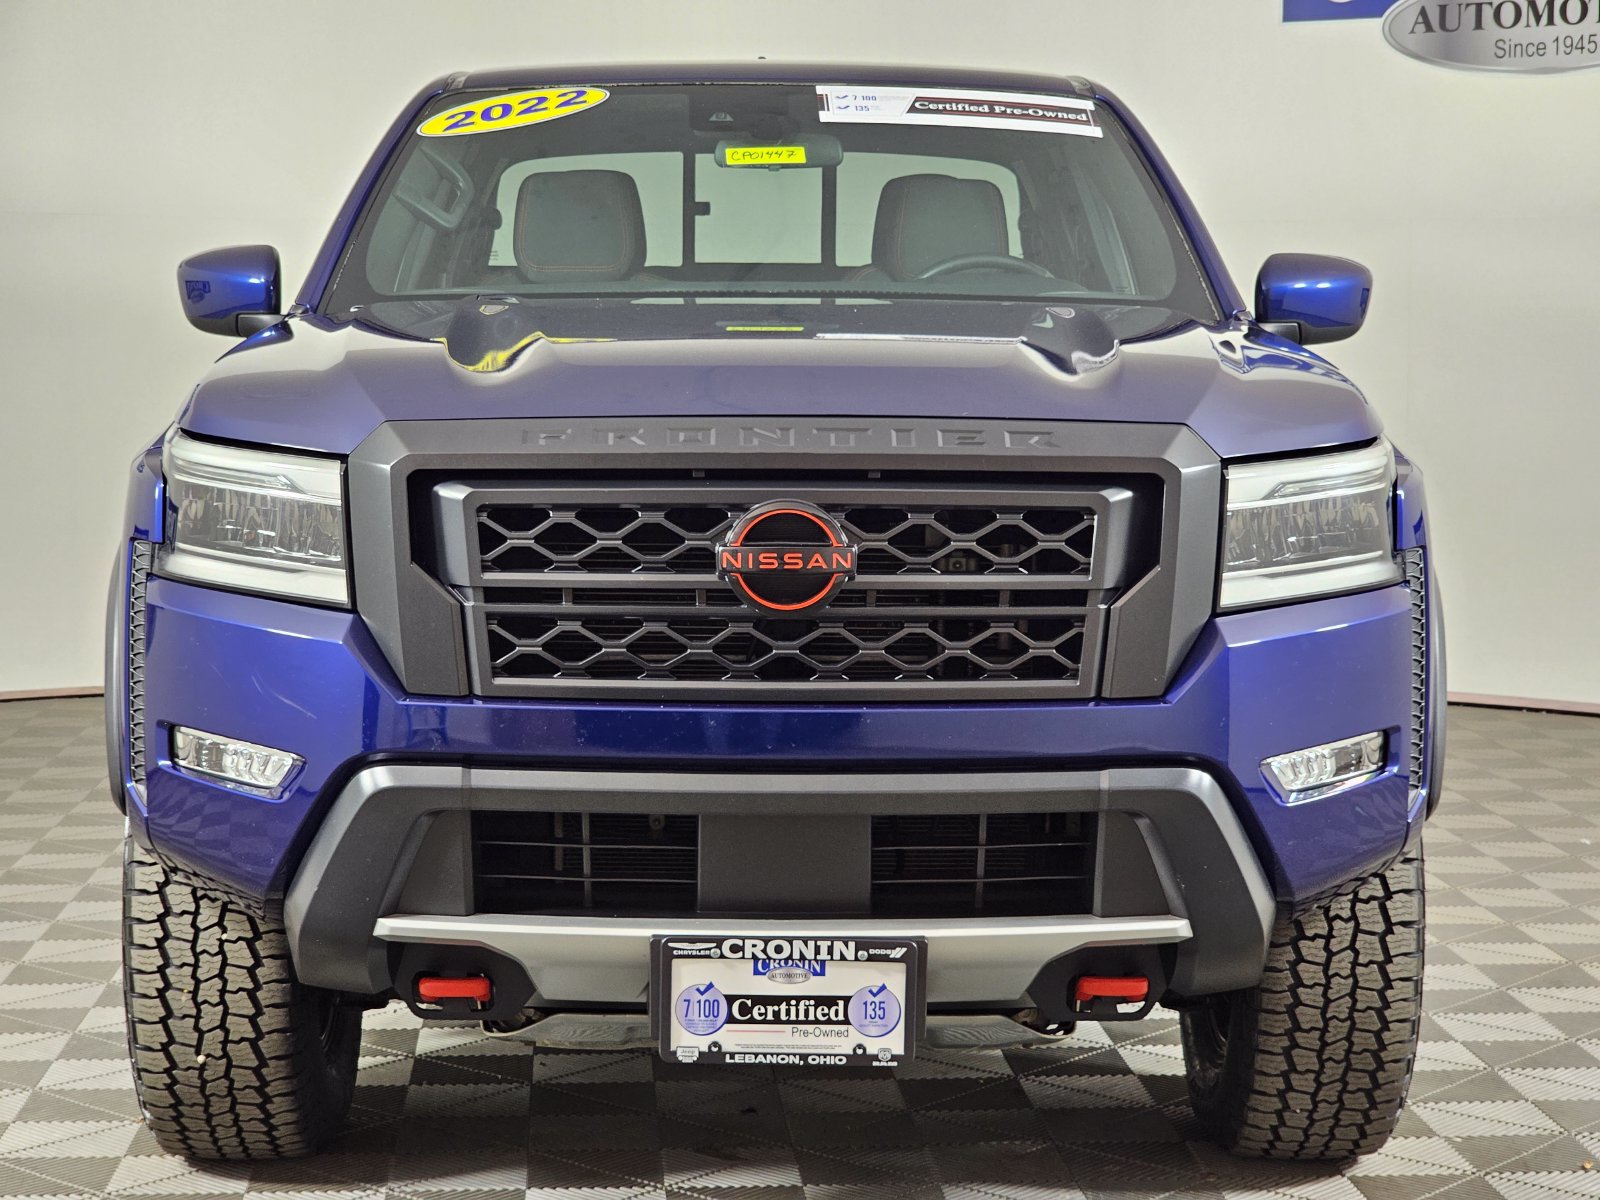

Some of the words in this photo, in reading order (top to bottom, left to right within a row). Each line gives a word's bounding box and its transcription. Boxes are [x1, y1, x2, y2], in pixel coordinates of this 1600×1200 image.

[1494, 39, 1547, 59] Since
[1552, 34, 1598, 56] 1945
[442, 90, 590, 132] 2022
[914, 101, 989, 114] Certified
[993, 104, 1088, 122] Pre-Owned
[721, 552, 853, 571] NISSAN
[721, 938, 856, 961] CRONIN
[731, 998, 845, 1022] Certified
[862, 1000, 886, 1020] 135
[791, 1026, 849, 1038] Pre-Owned
[725, 1053, 804, 1066] LEBANON,
[807, 1055, 847, 1065] OHIO
